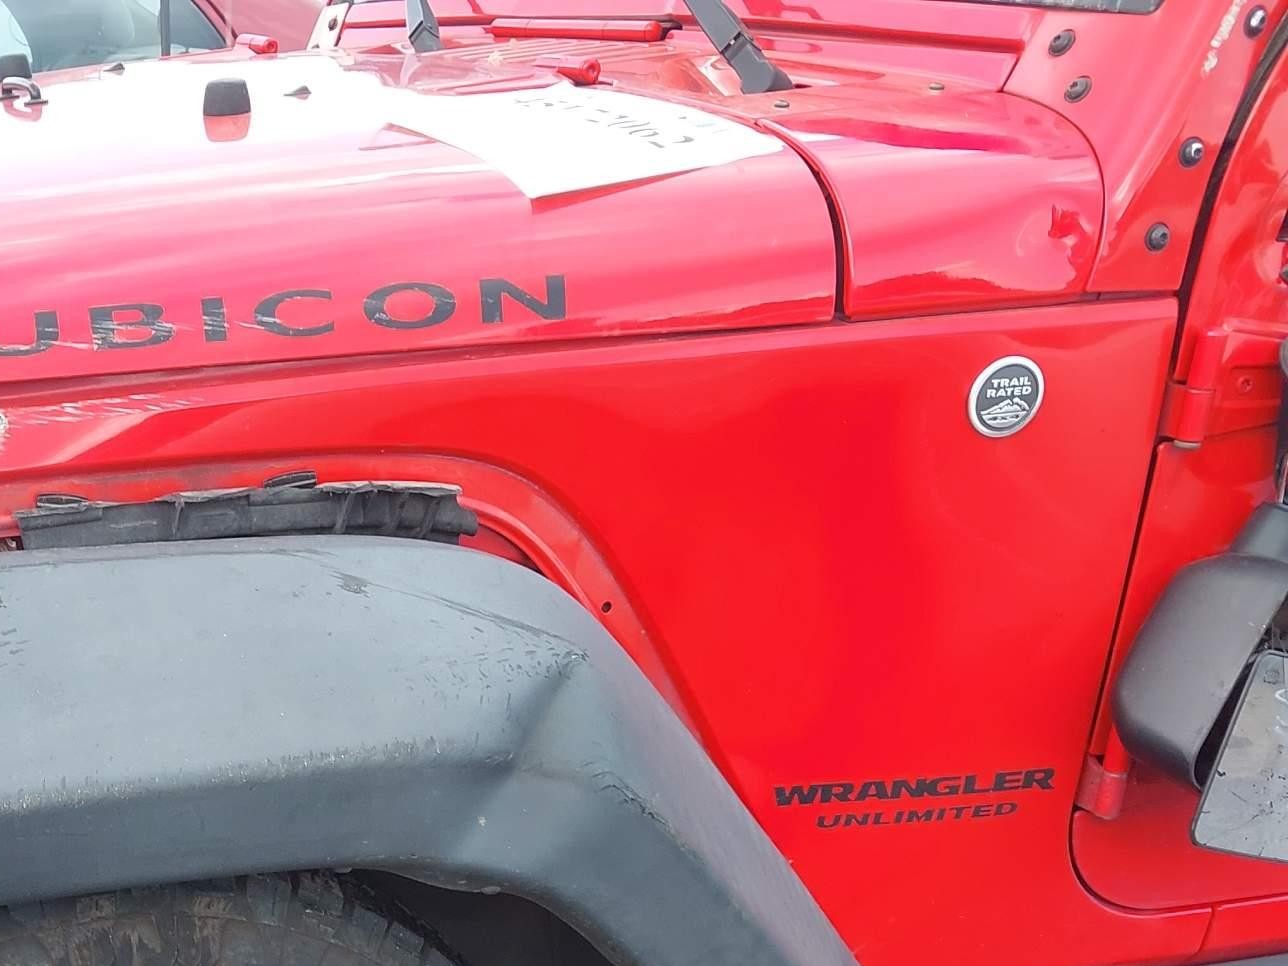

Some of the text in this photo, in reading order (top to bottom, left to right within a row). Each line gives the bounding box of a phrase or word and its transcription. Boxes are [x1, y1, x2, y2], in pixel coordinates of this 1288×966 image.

[991, 376, 1031, 388] TRAIL
[986, 386, 1032, 398] RATED
[773, 768, 1055, 806] WRANGLER
[816, 802, 1018, 828] UNLIMITED
